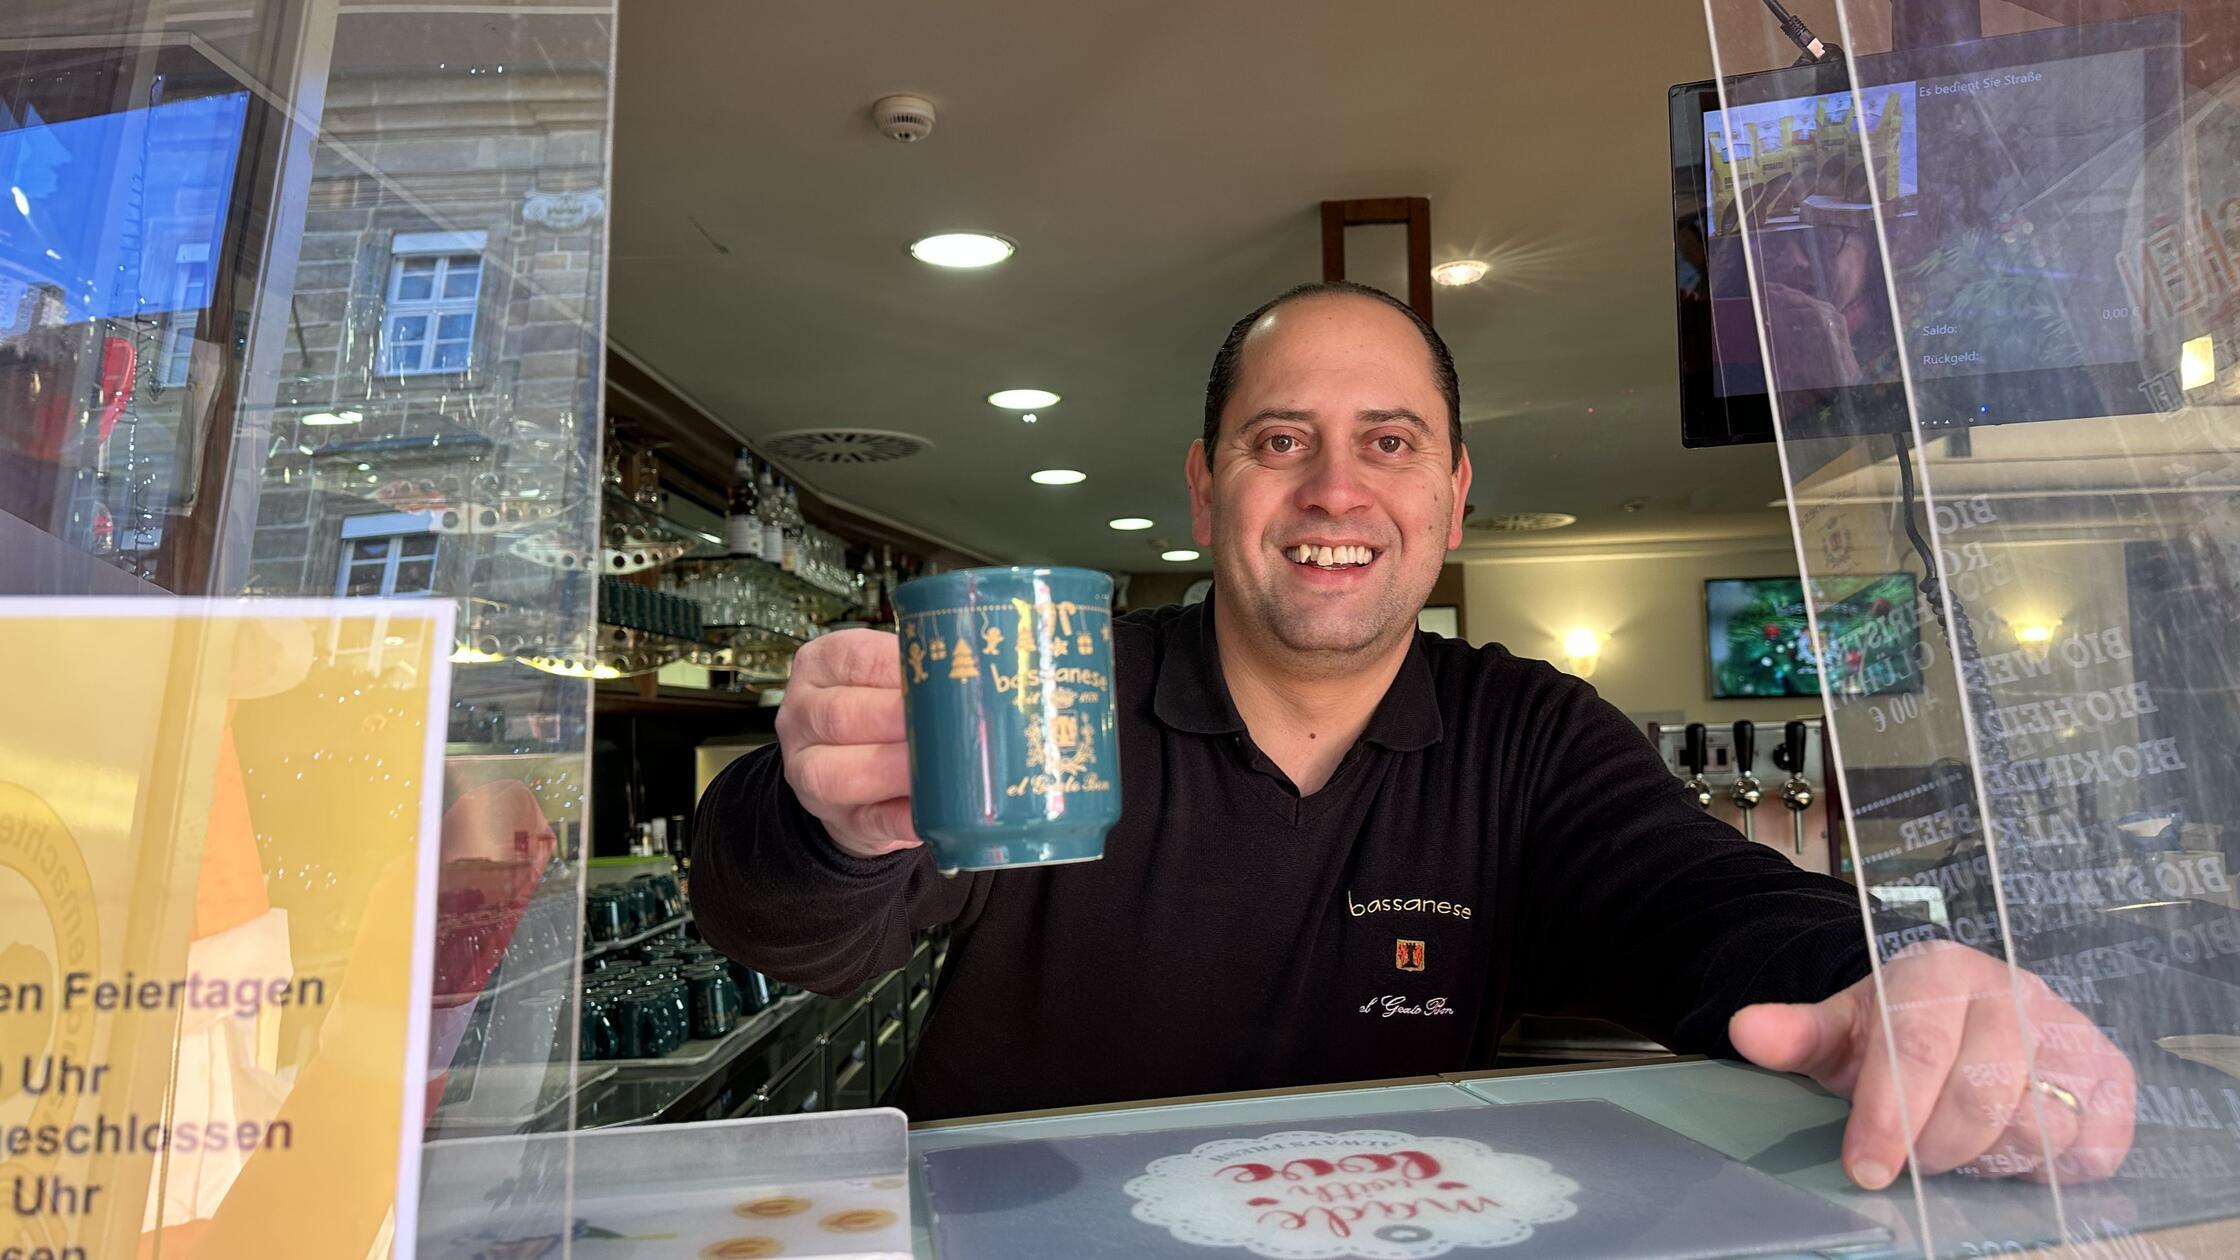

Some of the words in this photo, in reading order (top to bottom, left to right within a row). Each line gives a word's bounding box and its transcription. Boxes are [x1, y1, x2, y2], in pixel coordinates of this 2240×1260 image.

[1919, 86, 1932, 97] Es
[1935, 80, 1980, 95] bedient
[1983, 77, 2001, 89] Sie
[2004, 71, 2042, 85] Straße
[1922, 324, 1958, 337] Saldo:
[1348, 890, 1472, 919] bassanese
[63, 970, 325, 1017] Feiertagen
[20, 1054, 110, 1096] Uhr
[0, 1112, 294, 1160] eschlossen
[1213, 1150, 1442, 1183] love
[12, 1173, 103, 1217] Uhr
[1286, 1178, 1413, 1203] with
[1256, 1196, 1503, 1238] made
